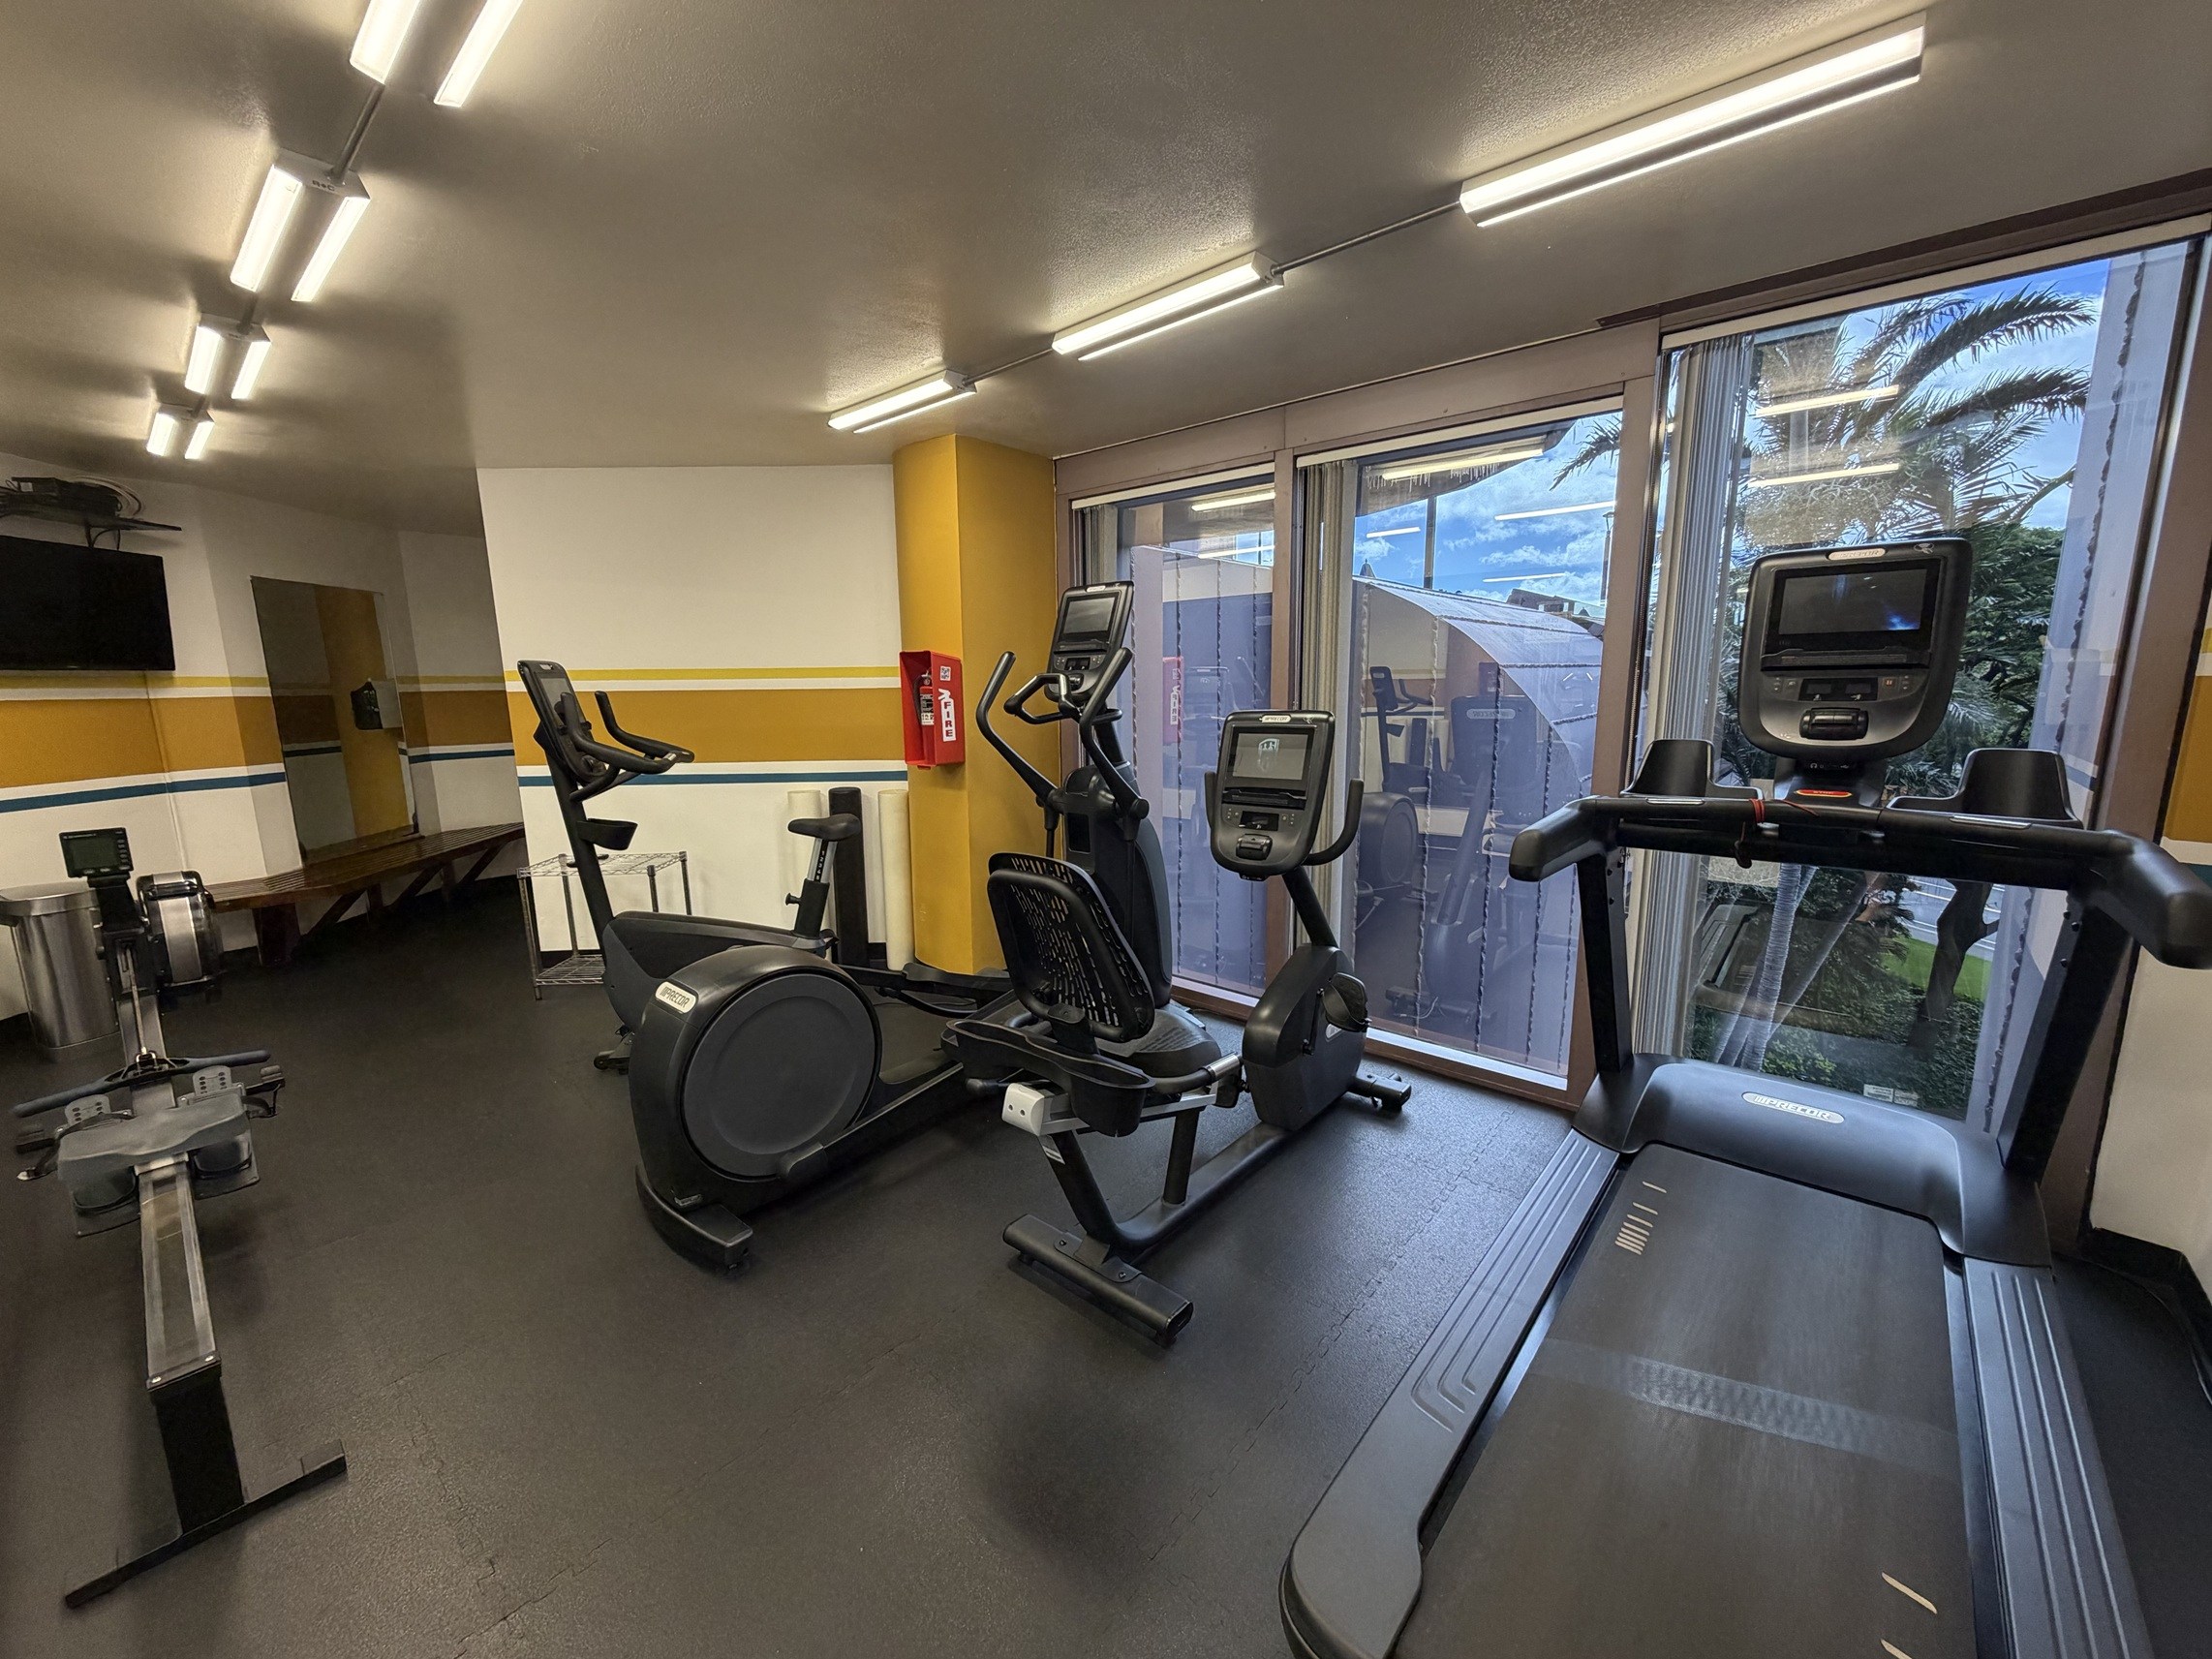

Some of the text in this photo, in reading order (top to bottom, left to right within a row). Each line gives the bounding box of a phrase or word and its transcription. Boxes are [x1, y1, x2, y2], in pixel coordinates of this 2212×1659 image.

[943, 701, 954, 737] FIRE
[665, 987, 691, 1008] PRECOR
[1762, 1098, 1831, 1121] PRECOR
